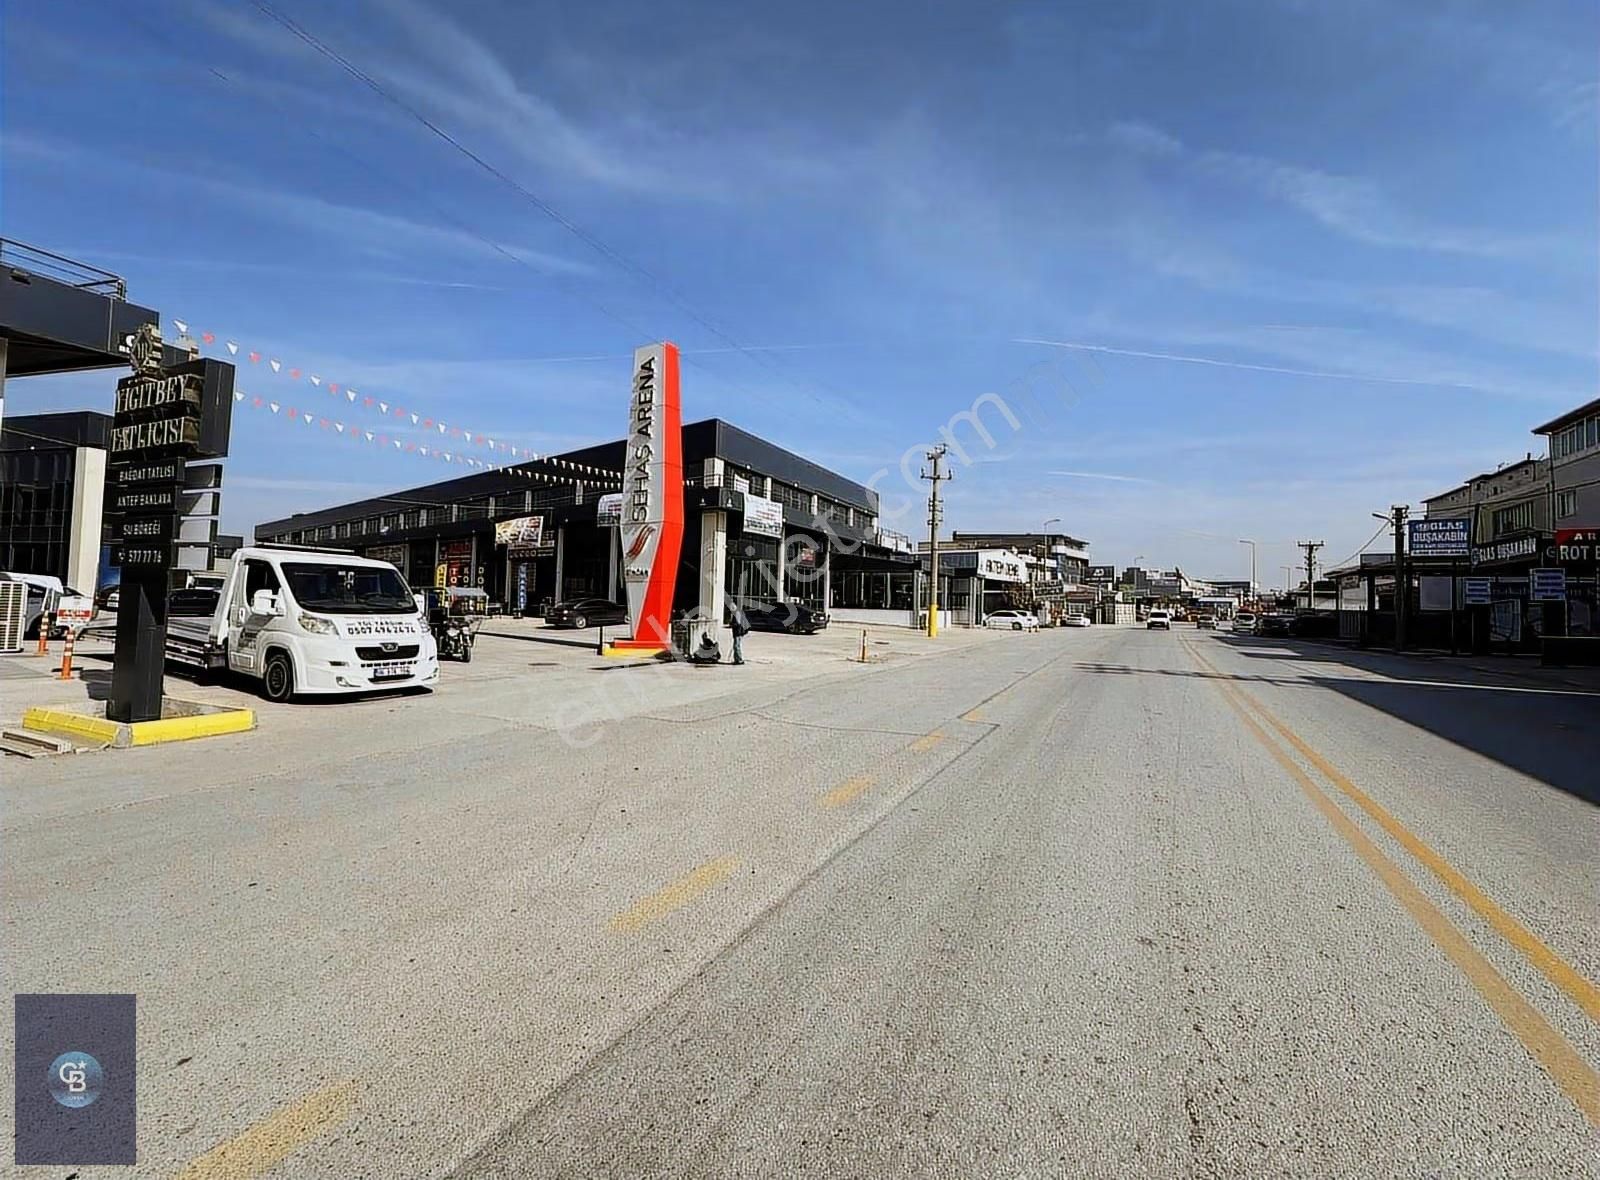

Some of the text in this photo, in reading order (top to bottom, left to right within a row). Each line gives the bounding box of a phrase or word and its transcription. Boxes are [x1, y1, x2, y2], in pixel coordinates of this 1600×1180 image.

[631, 356, 655, 523] SEHAS ARENA
[140, 493, 172, 507] BAKLAVA
[1413, 530, 1468, 544] DUŞAKABİN
[1560, 545, 1590, 561] ROT
